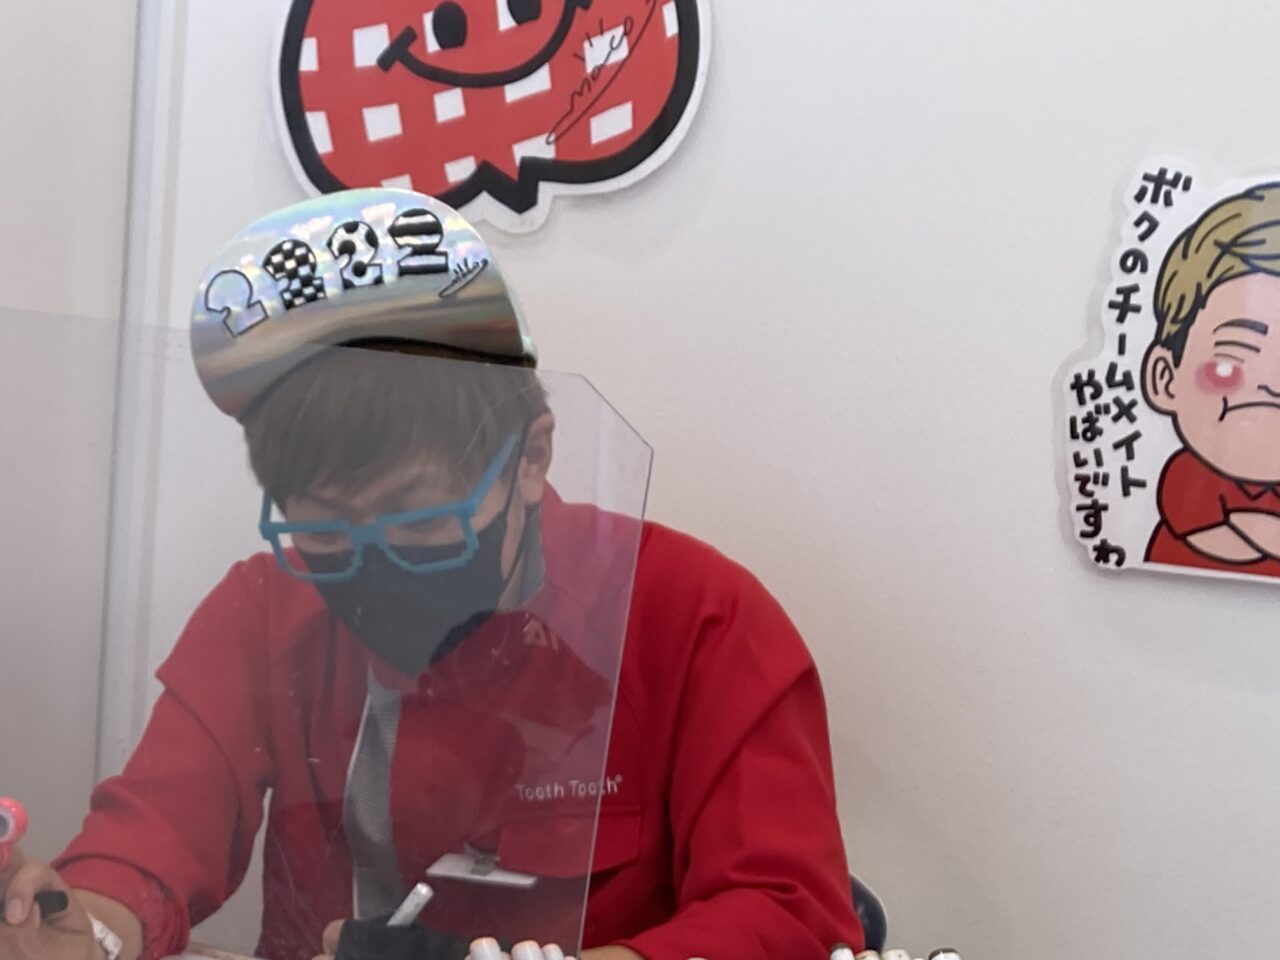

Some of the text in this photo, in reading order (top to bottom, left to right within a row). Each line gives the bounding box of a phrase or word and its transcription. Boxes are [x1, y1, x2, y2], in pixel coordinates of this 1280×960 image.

[1107, 166, 1193, 497] ボクのチームメイト
[1069, 367, 1127, 567] やばいですわ
[515, 782, 565, 801] Tooth
